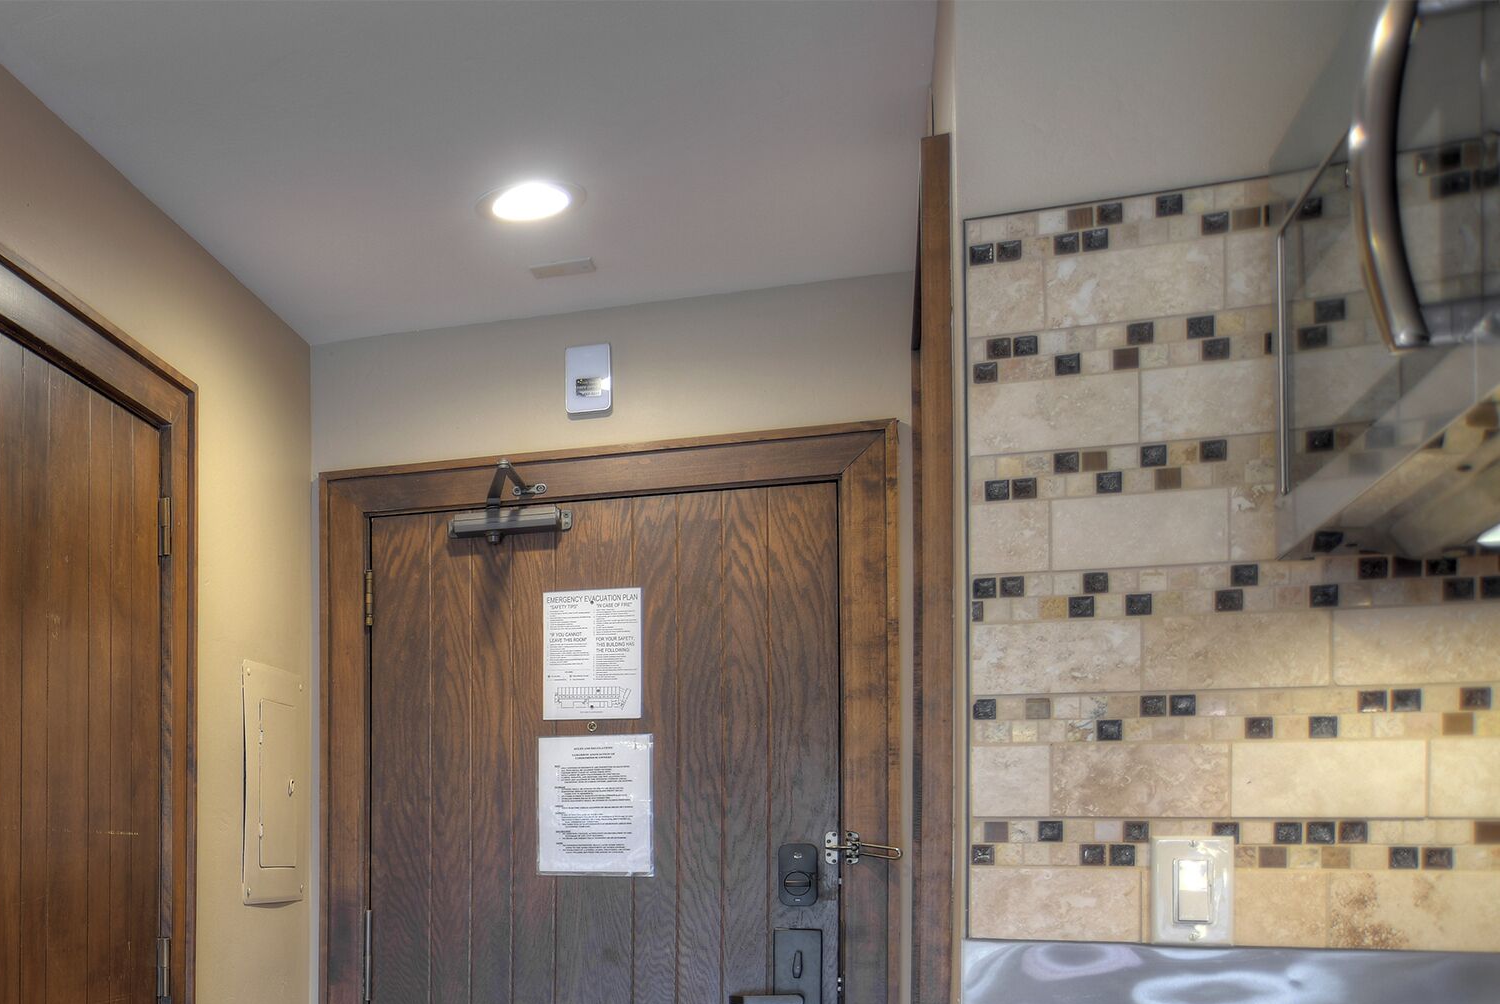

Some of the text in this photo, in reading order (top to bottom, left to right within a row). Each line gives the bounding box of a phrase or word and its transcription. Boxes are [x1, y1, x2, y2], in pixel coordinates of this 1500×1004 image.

[547, 593, 638, 604] EMERGENCY EVACUATION PLAN
